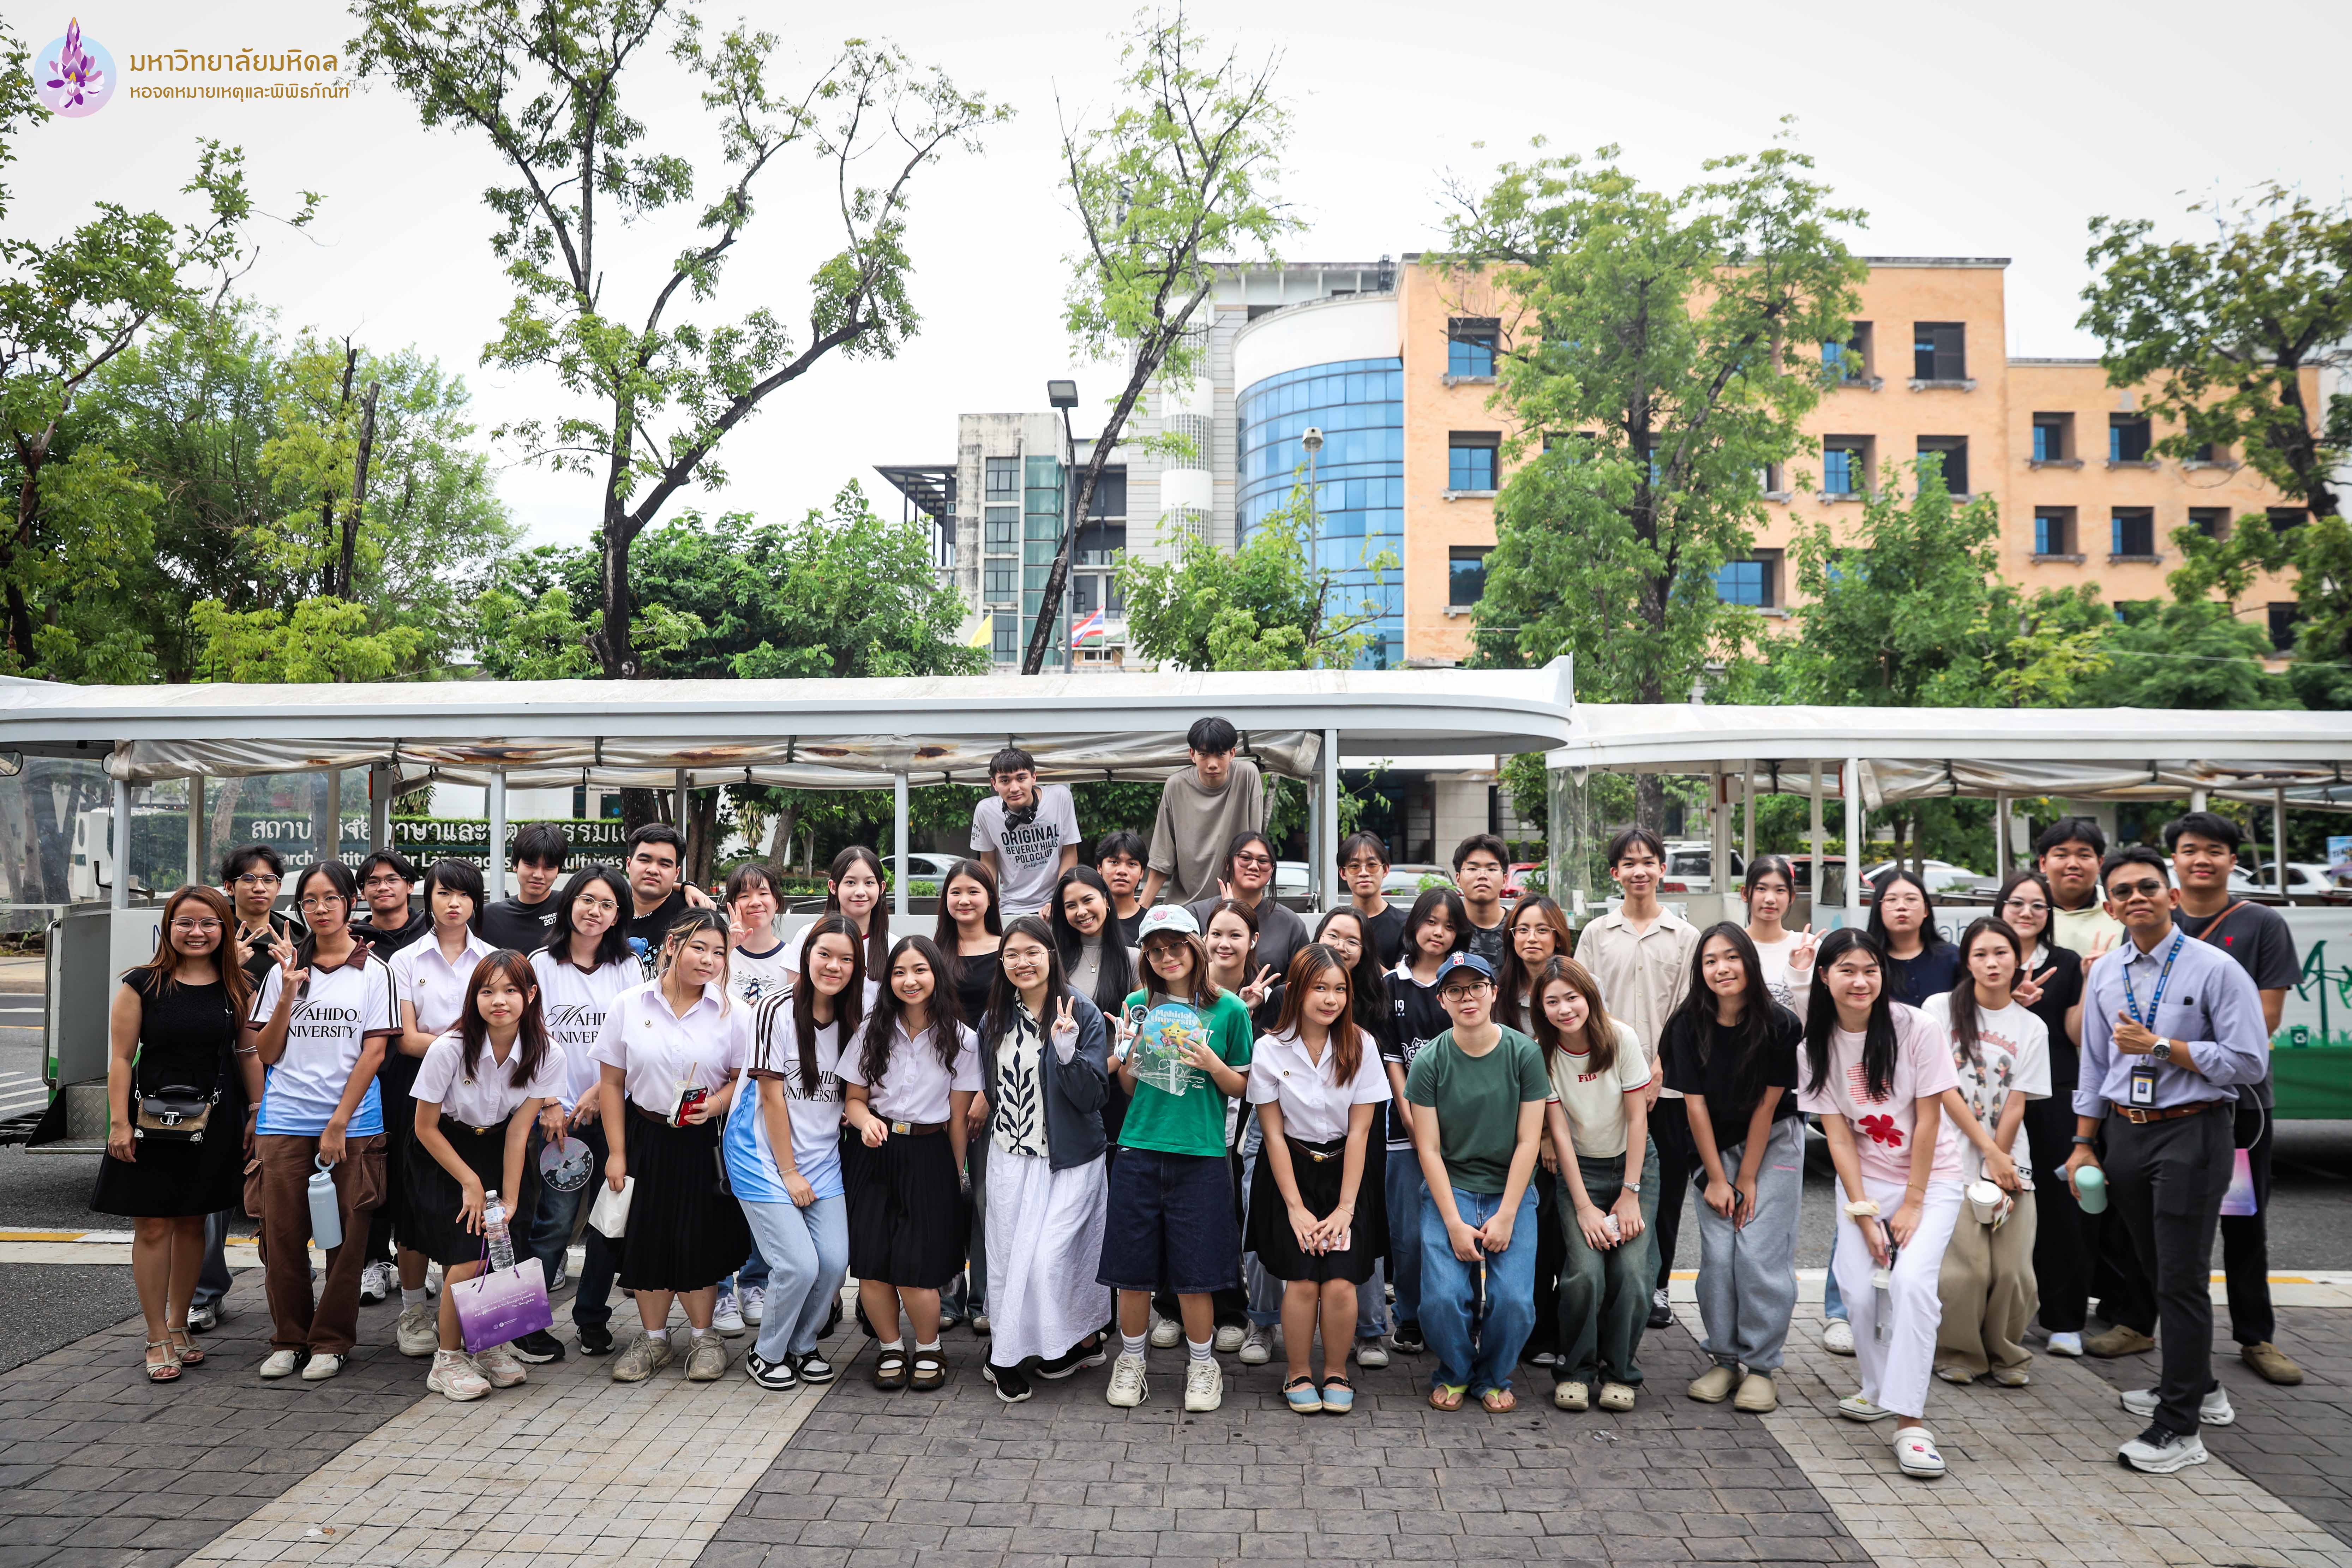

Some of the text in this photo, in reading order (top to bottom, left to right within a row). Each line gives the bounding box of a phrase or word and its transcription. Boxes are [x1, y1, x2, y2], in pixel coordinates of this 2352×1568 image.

[1001, 823, 1059, 846] ORIGINAL
[1005, 843, 1039, 855] BEVERLY
[1015, 853, 1035, 864] POLO
[1395, 999, 1405, 1012] 19
[1156, 1009, 1192, 1019] Mahidol
[288, 1026, 357, 1038] NIVERSITY
[1578, 1073, 1597, 1082] Fila
